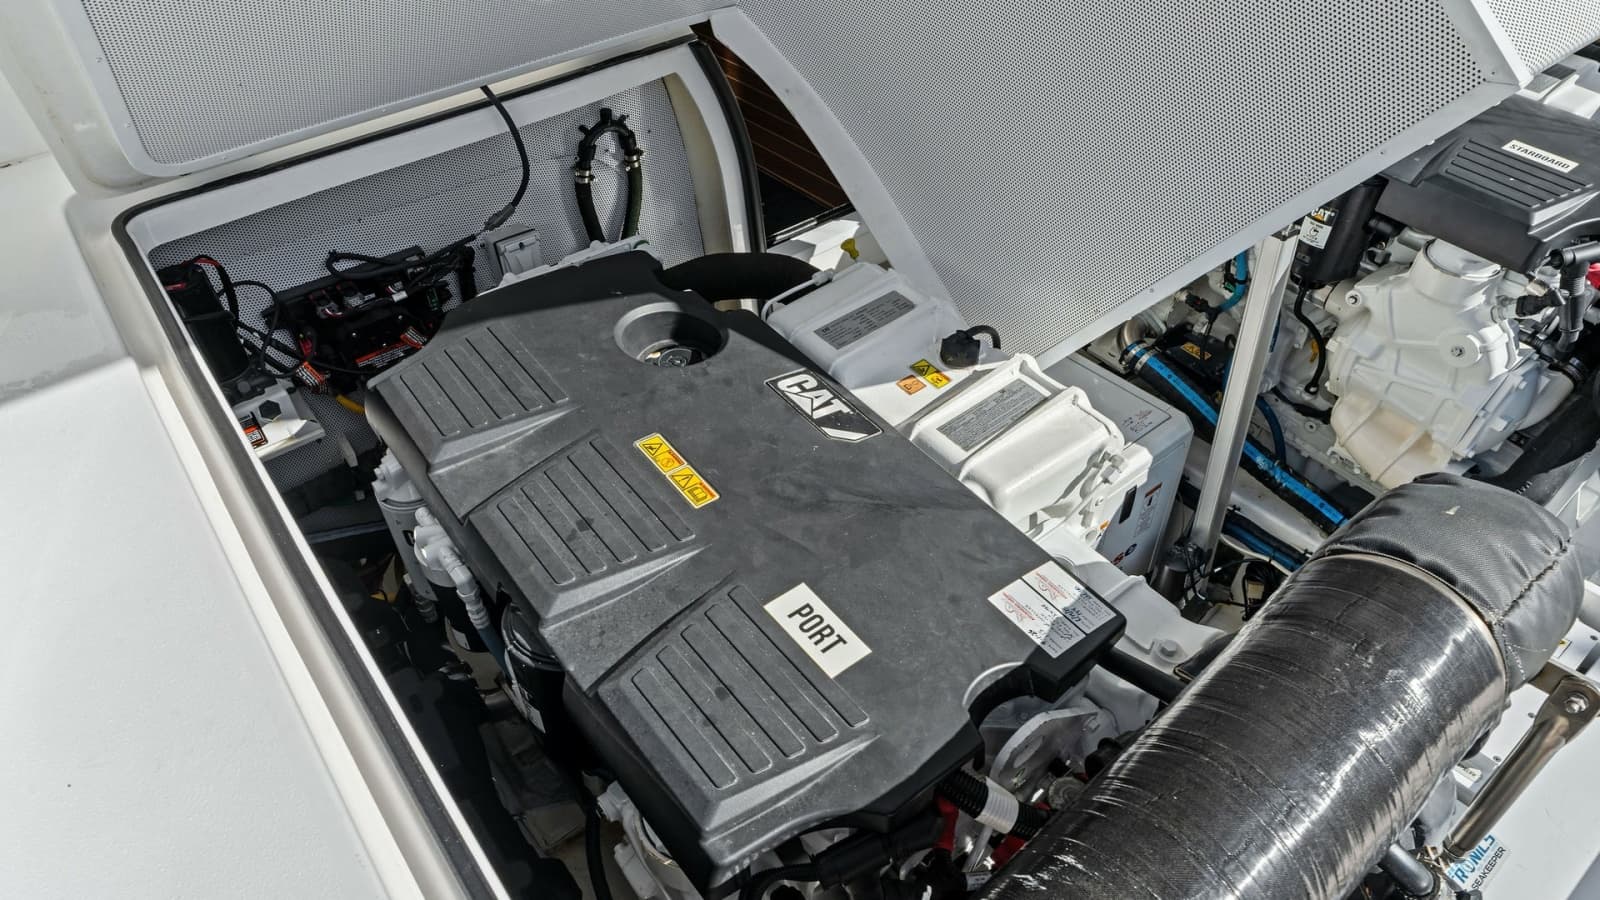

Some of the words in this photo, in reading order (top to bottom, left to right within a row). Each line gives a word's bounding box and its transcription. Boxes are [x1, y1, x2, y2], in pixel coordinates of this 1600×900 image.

[1509, 143, 1570, 169] STARBOARD
[1311, 207, 1332, 221] CAT
[777, 374, 851, 420] CAT
[787, 603, 848, 654] PORT
[1471, 846, 1507, 890] SEAKEEPER
